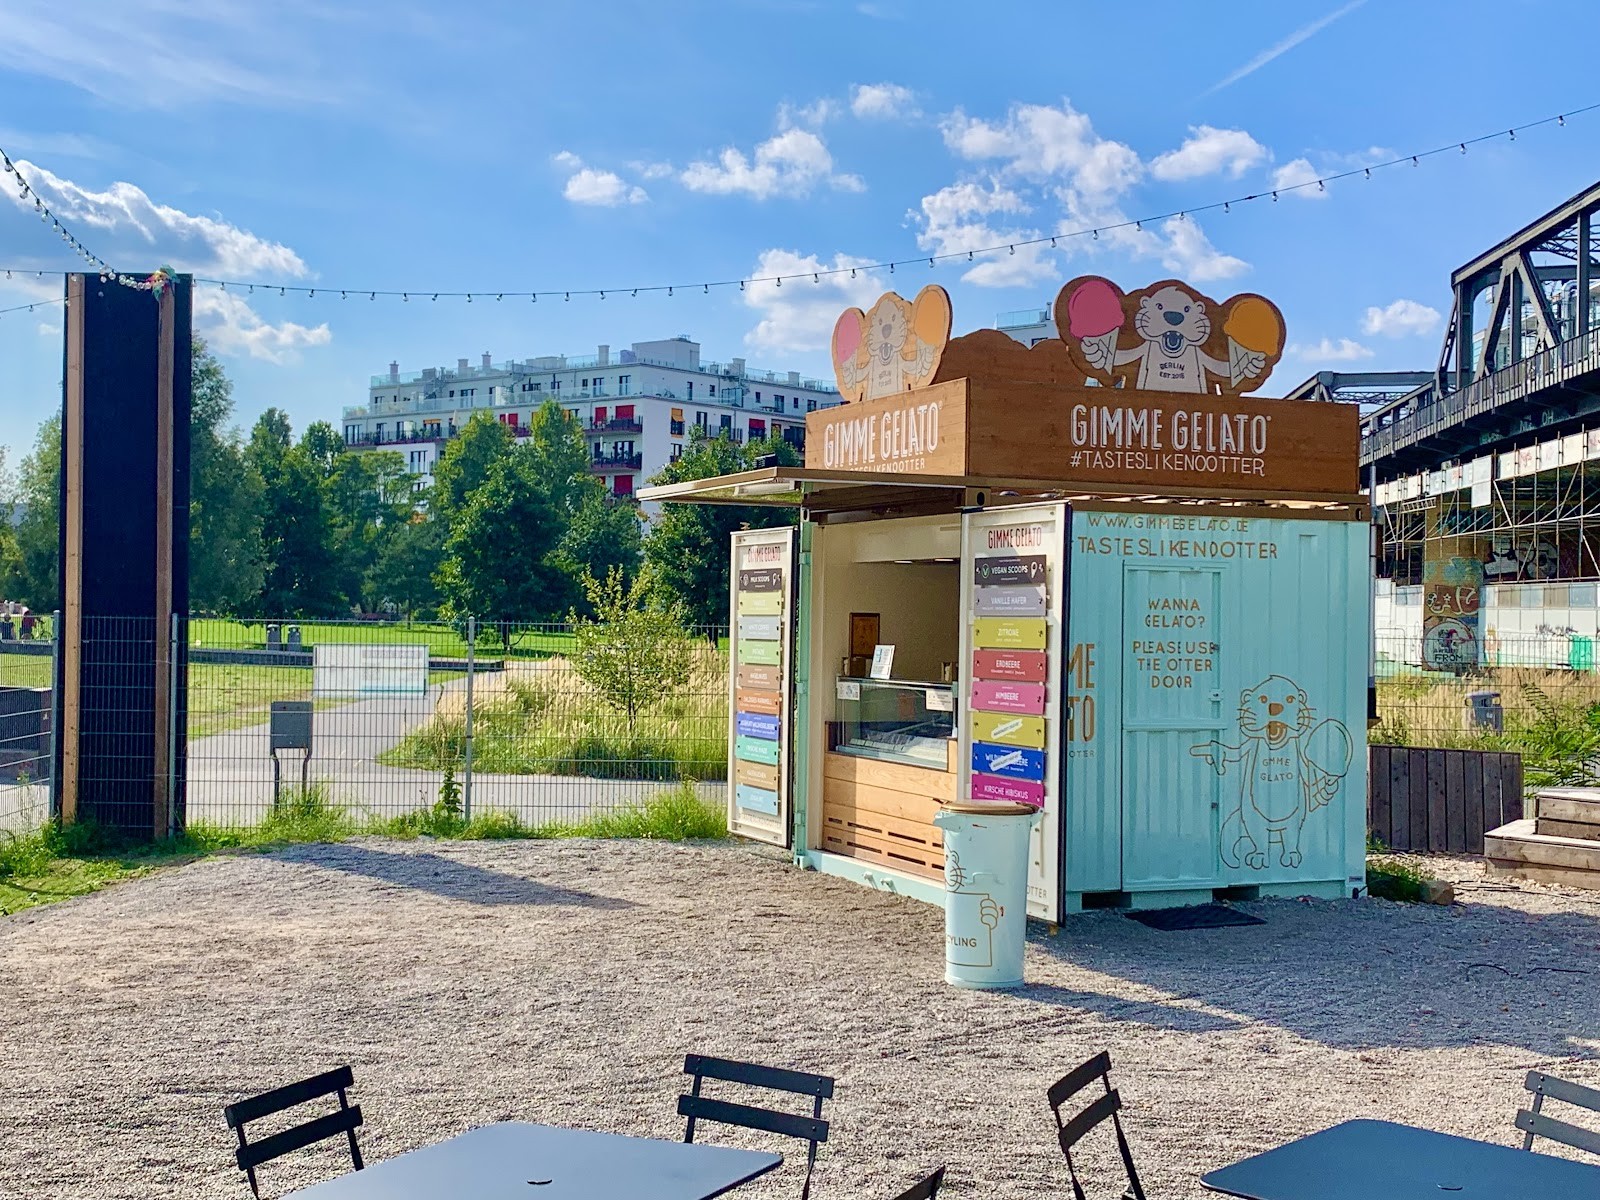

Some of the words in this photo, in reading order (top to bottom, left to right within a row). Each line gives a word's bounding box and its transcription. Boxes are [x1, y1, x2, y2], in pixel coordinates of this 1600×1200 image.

[1159, 361, 1185, 371] BERLIN
[824, 415, 876, 469] GIMME
[880, 401, 939, 460] GELATO
[1071, 404, 1163, 450] GIMME
[1171, 409, 1268, 455] GELATO
[1070, 450, 1266, 477] #TASTESLIKENOOTTER
[988, 528, 1013, 549] GIMME
[1015, 526, 1042, 547] GELATO
[991, 566, 1007, 574] VEGAN
[1007, 565, 1029, 574] SCOOPS
[1148, 598, 1201, 611] WANNA
[1144, 614, 1205, 628] GELATO?
[1132, 641, 1181, 654] PLEASE
[1166, 658, 1213, 672] OTTER
[1151, 675, 1192, 688] DOOR
[984, 785, 1005, 796] KIRSCHE
[1004, 788, 1029, 800] HIBISKUS
